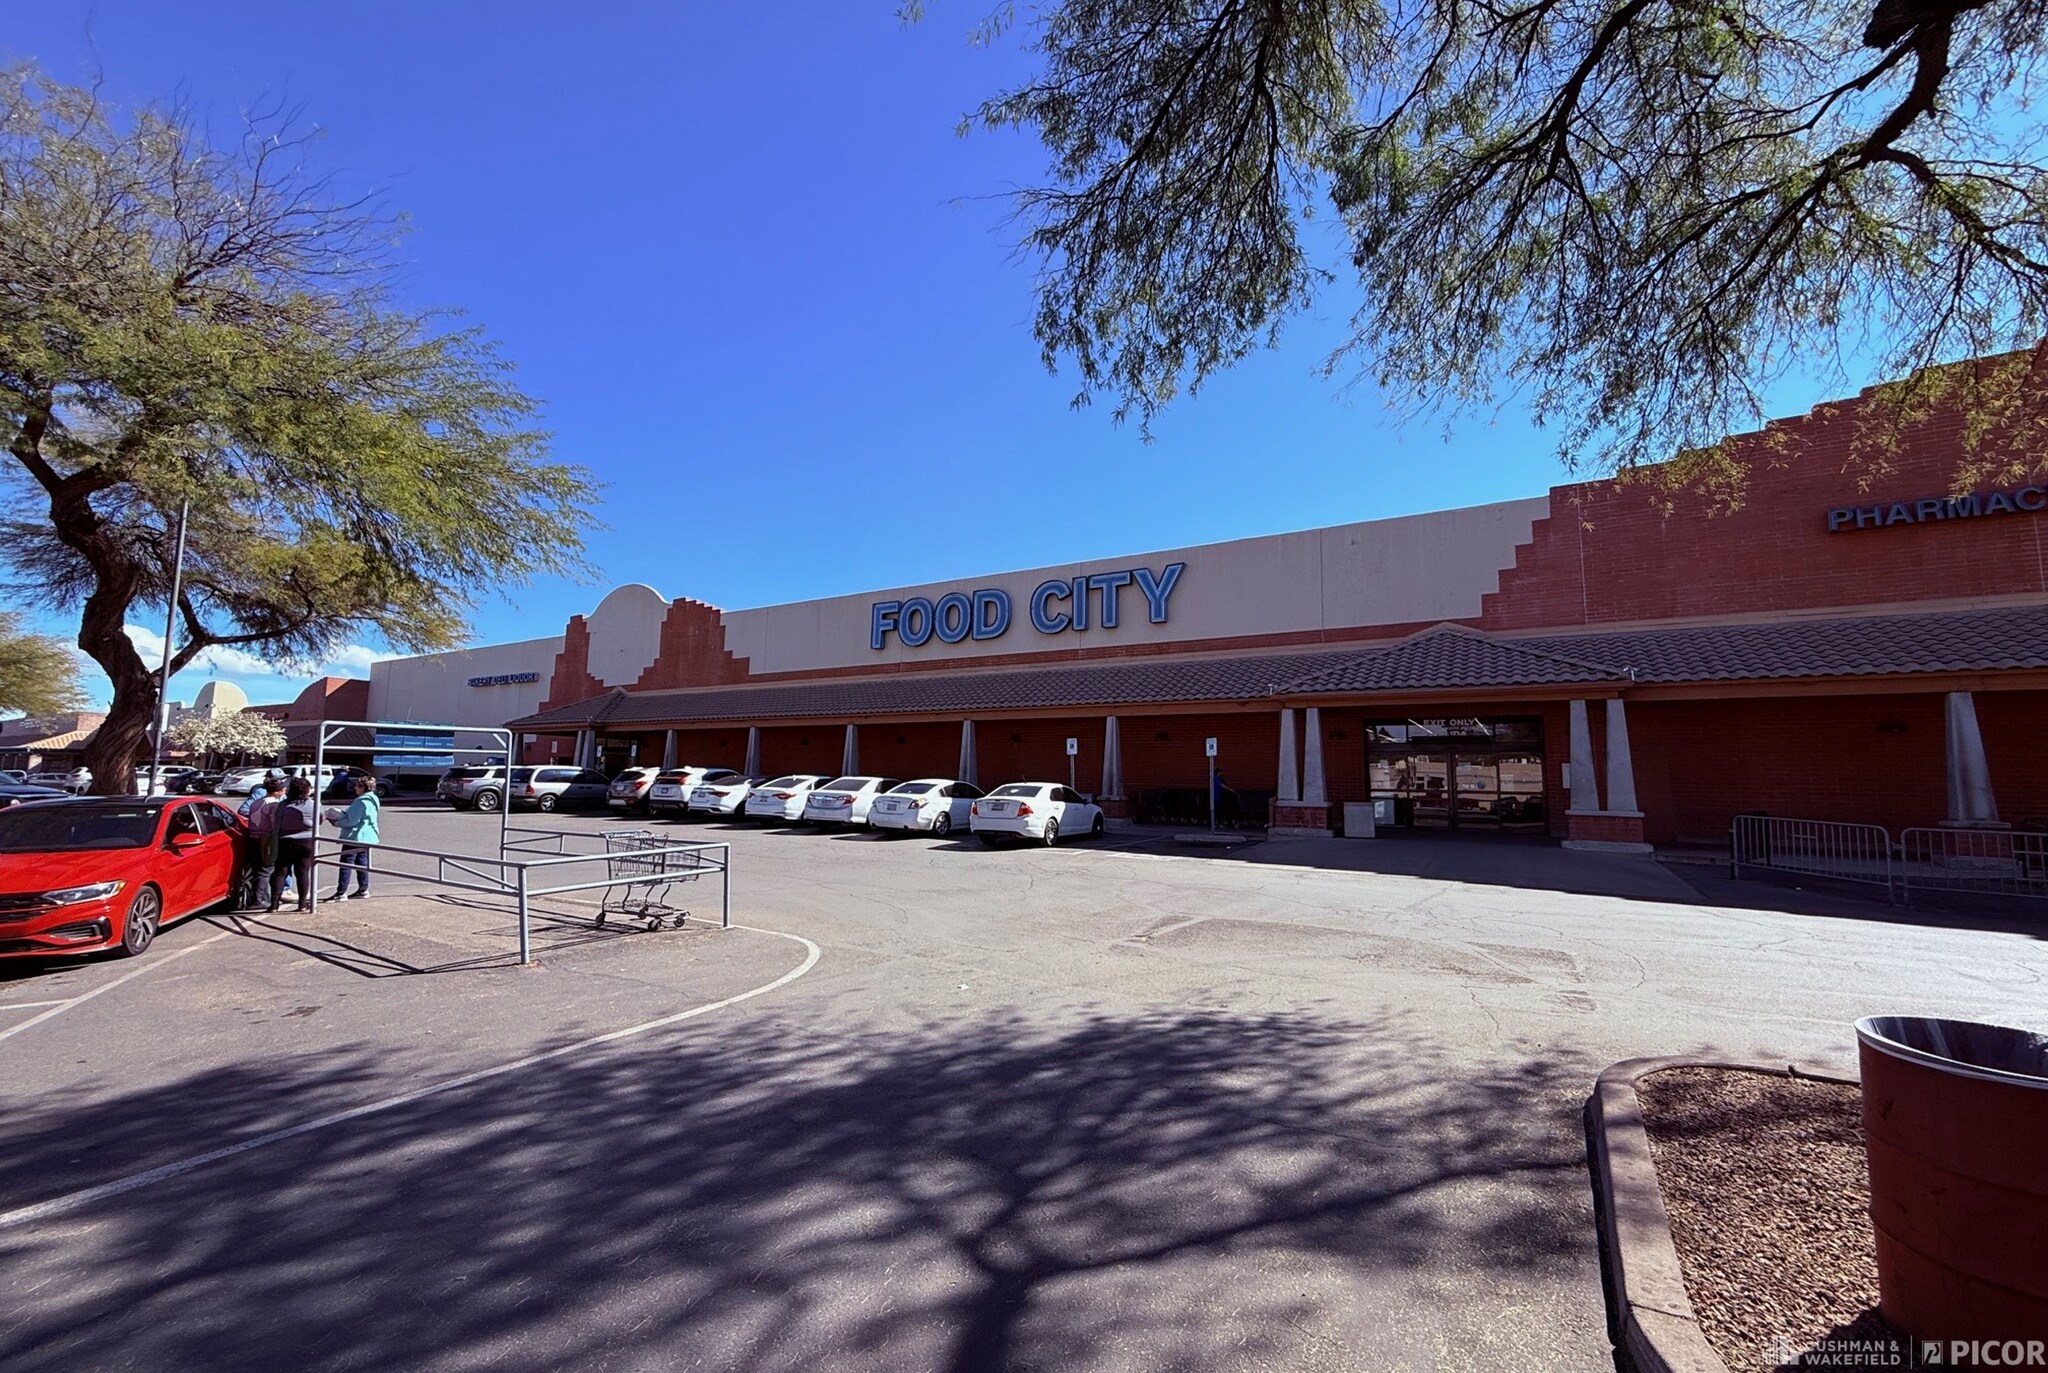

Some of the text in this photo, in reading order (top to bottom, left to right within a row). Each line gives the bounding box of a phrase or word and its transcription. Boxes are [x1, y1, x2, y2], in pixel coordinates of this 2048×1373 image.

[1827, 486, 2048, 533] PHARMAC
[870, 561, 1187, 649] FOOD CITY
[1449, 718, 1475, 726] ONLY
